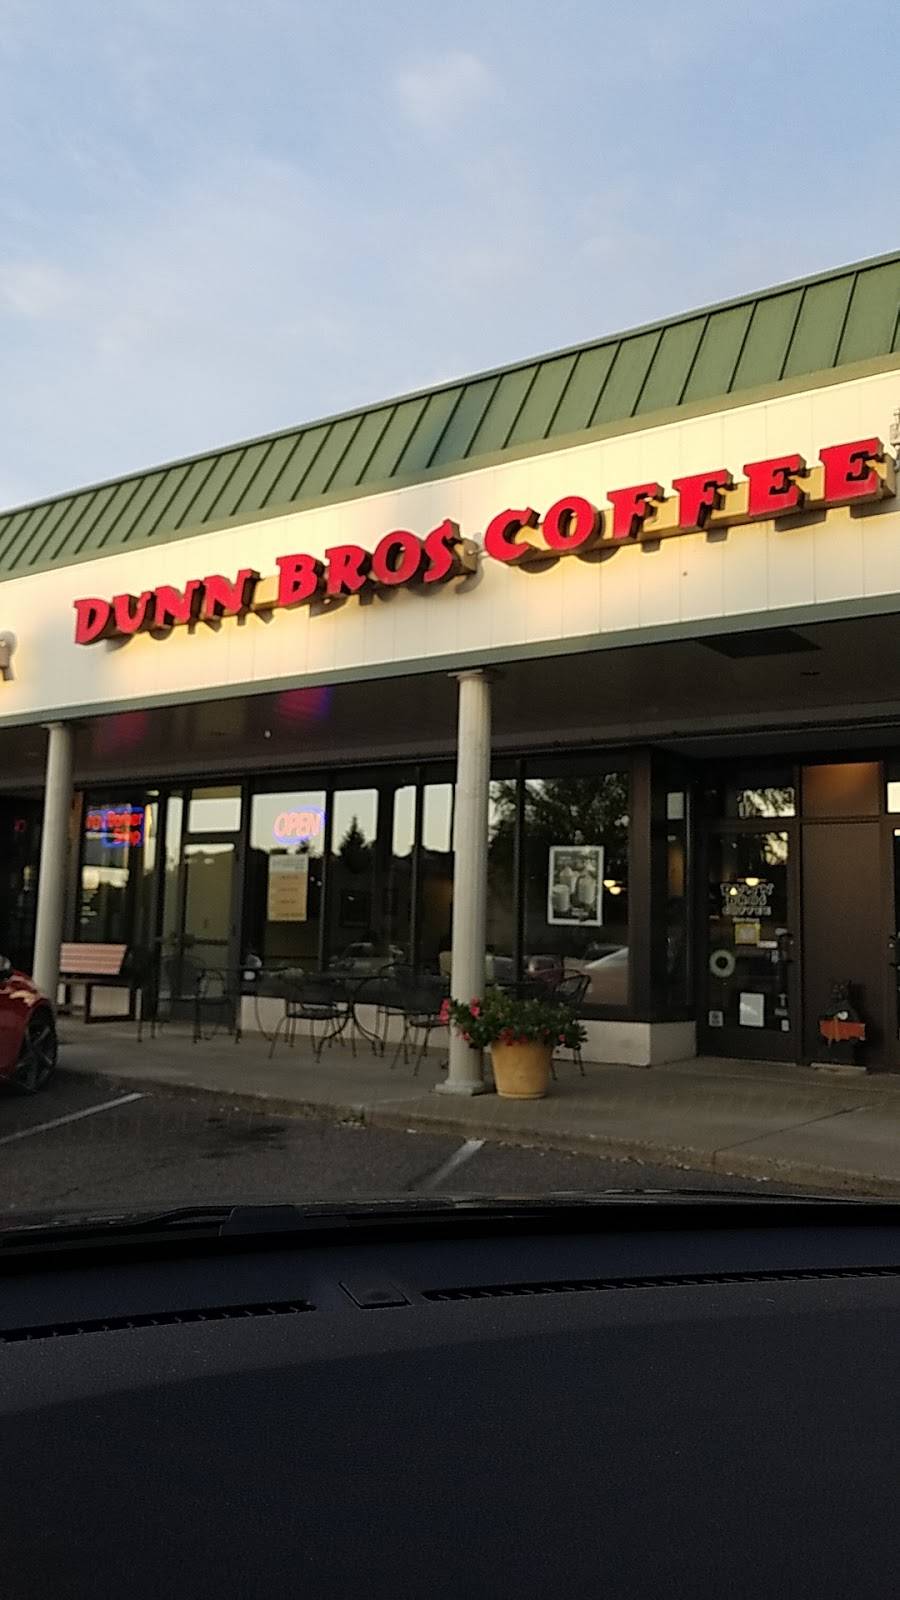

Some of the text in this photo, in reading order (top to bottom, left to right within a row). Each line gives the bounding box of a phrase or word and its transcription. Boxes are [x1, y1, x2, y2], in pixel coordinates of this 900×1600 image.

[74, 437, 882, 644] DUNN BROS COFFEE
[274, 812, 320, 838] OPEN
